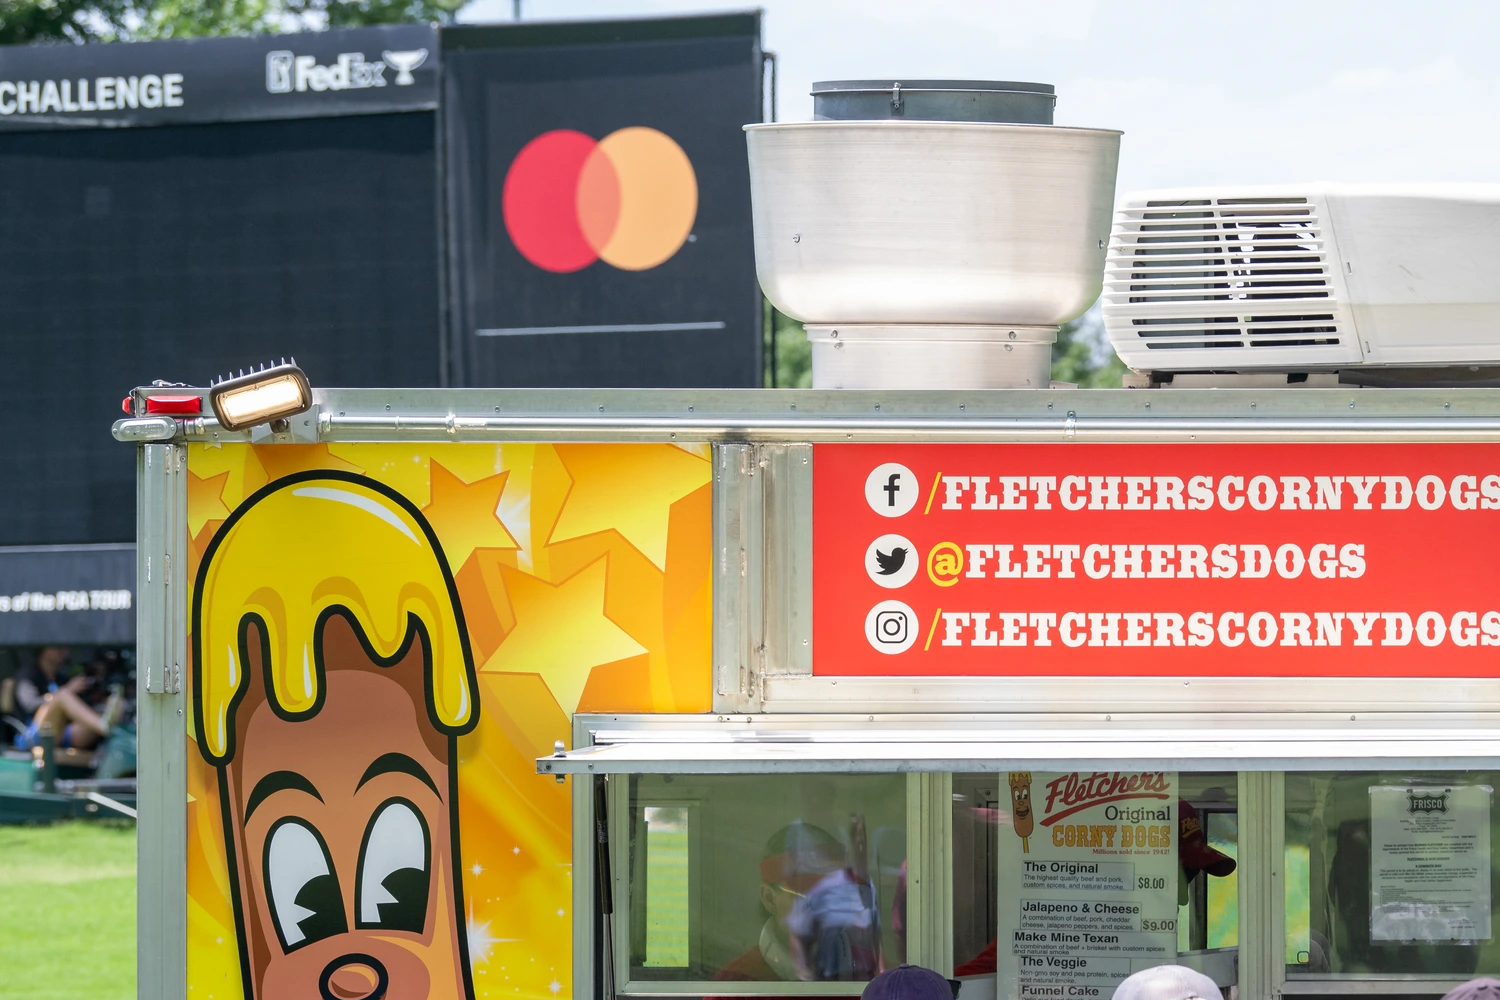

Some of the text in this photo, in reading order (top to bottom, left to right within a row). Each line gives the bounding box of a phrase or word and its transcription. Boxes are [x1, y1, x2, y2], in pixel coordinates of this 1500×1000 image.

[295, 51, 387, 92] FedEx
[0, 73, 184, 115] CHALLENGE
[927, 541, 1366, 588] @FLETCHERSDOGS
[1044, 772, 1170, 813] Fletchers
[1413, 799, 1443, 809] FRISCO
[1105, 805, 1171, 823] Original
[1052, 825, 1117, 848] CORNY
[1121, 825, 1171, 848] DOGS
[1024, 862, 1098, 875] The Original
[1037, 875, 1058, 883] highest
[1138, 877, 1164, 889] $8.00
[1023, 902, 1139, 914] Jalapeno & Cheese
[1143, 921, 1174, 931] $9.00
[1015, 932, 1119, 943] Make Mine Texan
[1021, 956, 1087, 969] The Veggie
[1021, 986, 1099, 995] Funnel Cake
